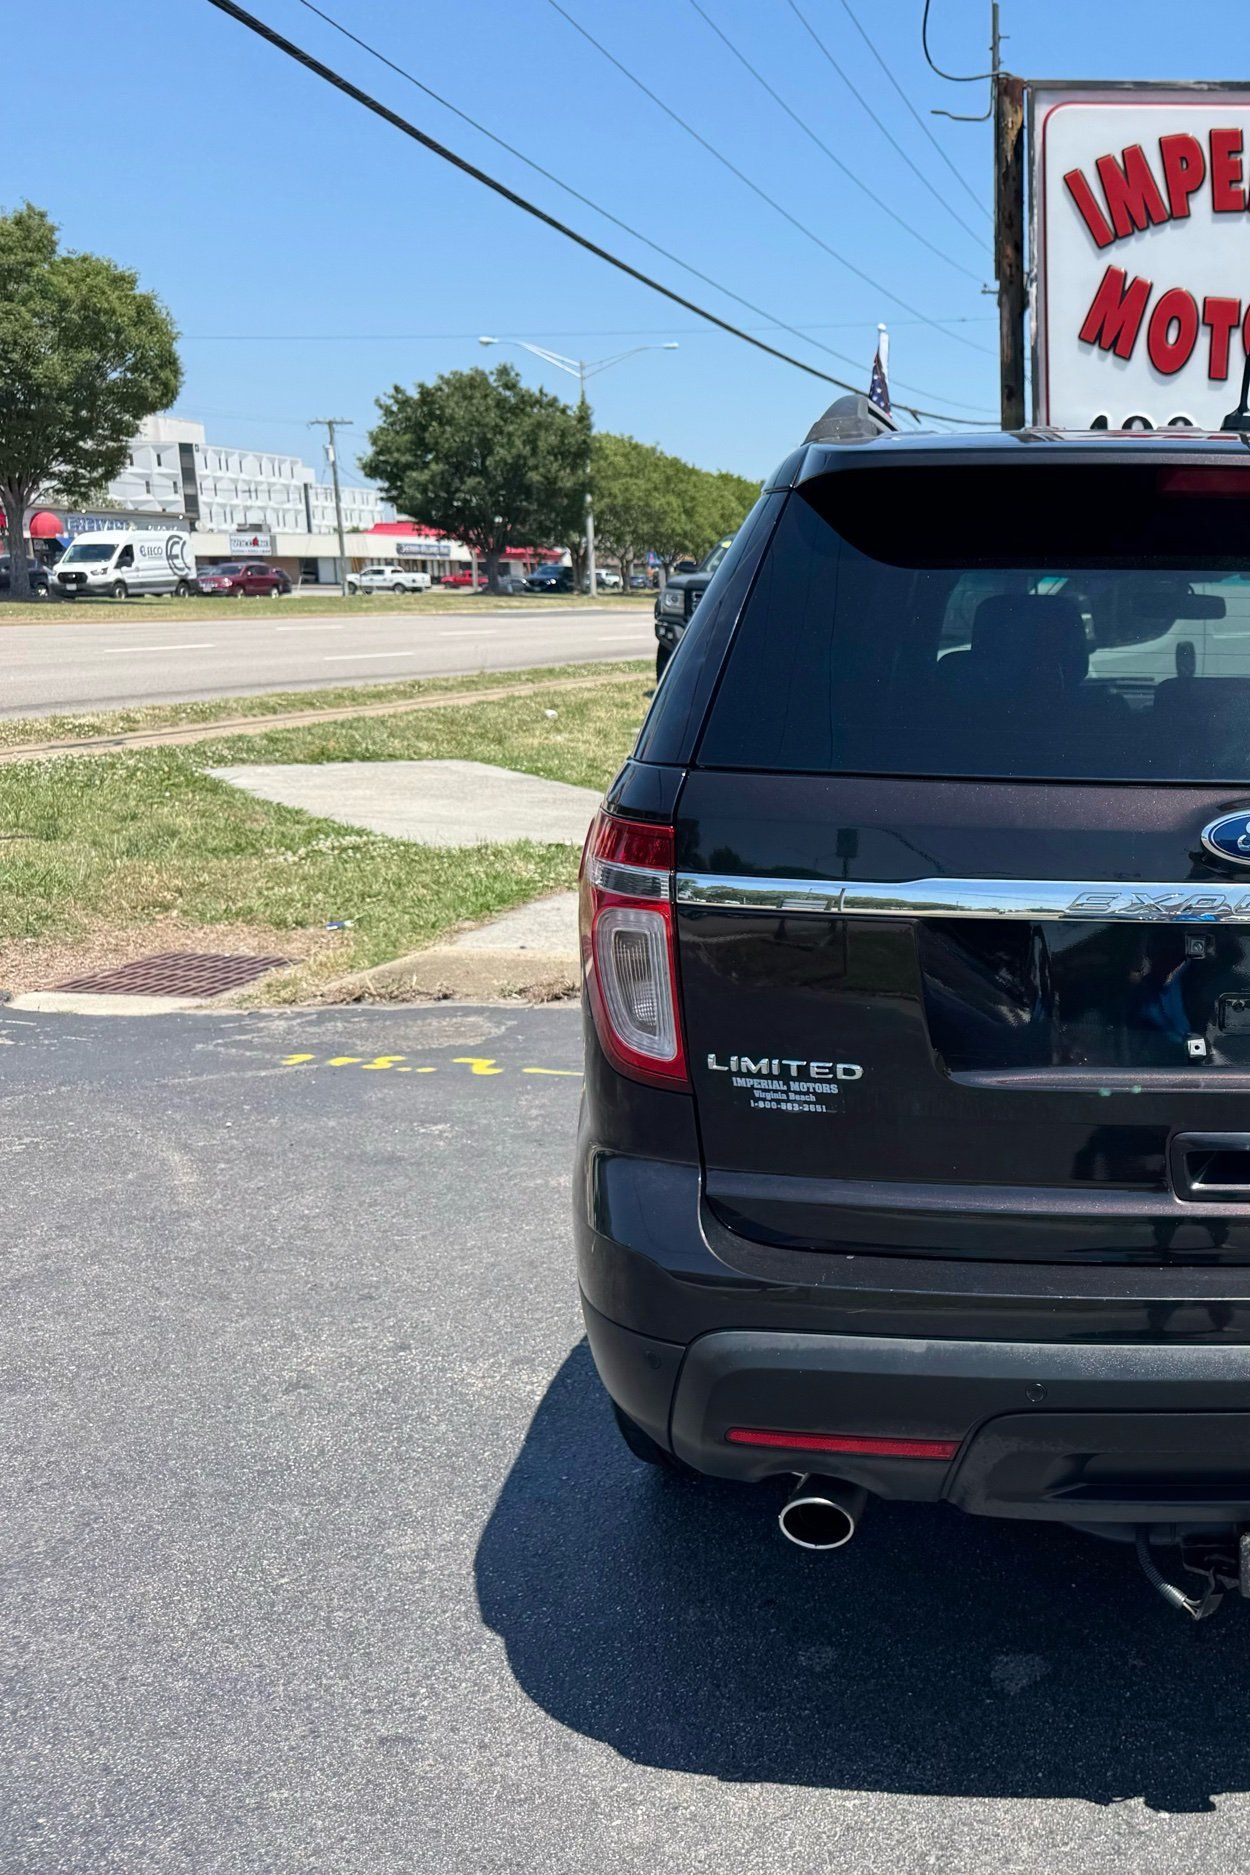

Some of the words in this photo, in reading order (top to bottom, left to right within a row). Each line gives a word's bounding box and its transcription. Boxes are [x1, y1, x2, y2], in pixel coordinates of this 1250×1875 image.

[707, 1053, 865, 1080] LIMITED
[732, 1077, 788, 1091] IMPERIAL
[789, 1081, 839, 1094] MOTORS
[753, 1089, 788, 1101] Virginia
[789, 1092, 817, 1102] Beach
